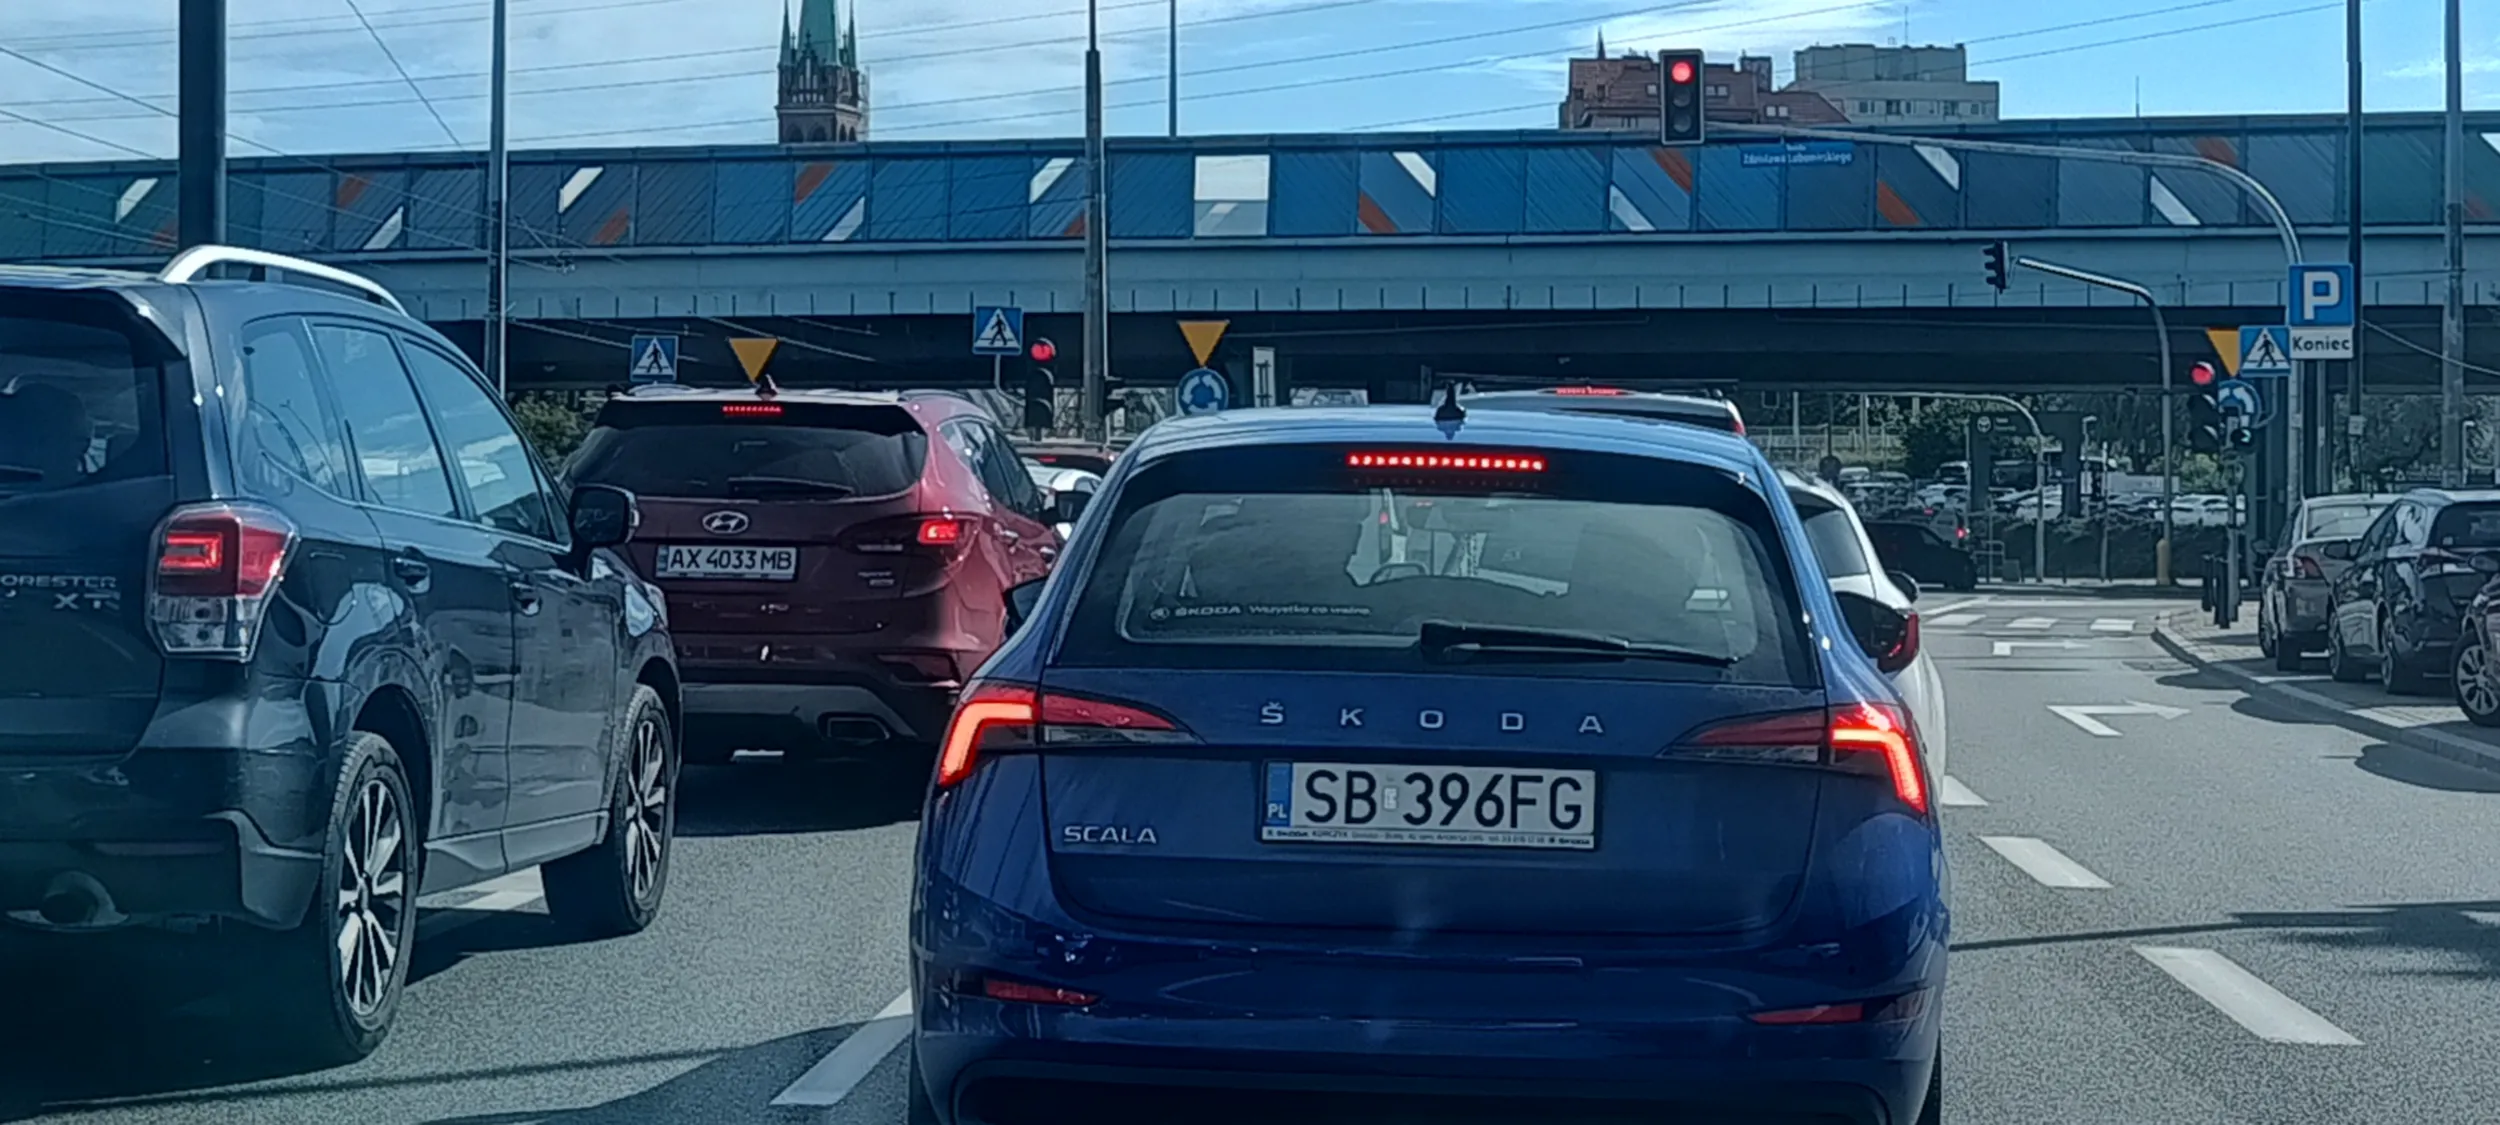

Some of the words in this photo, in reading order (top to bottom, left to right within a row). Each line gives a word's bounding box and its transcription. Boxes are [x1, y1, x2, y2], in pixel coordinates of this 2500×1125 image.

[2303, 271, 2340, 320] P
[2292, 335, 2351, 351] Koniec
[670, 549, 702, 569] AX
[706, 549, 757, 570] 4033
[760, 551, 792, 570] MB
[1260, 702, 1603, 733] ŠKODA
[1304, 769, 1377, 825] SB
[1402, 772, 1583, 830] 396FG
[1268, 803, 1287, 819] PL
[1063, 826, 1157, 844] SCALA
